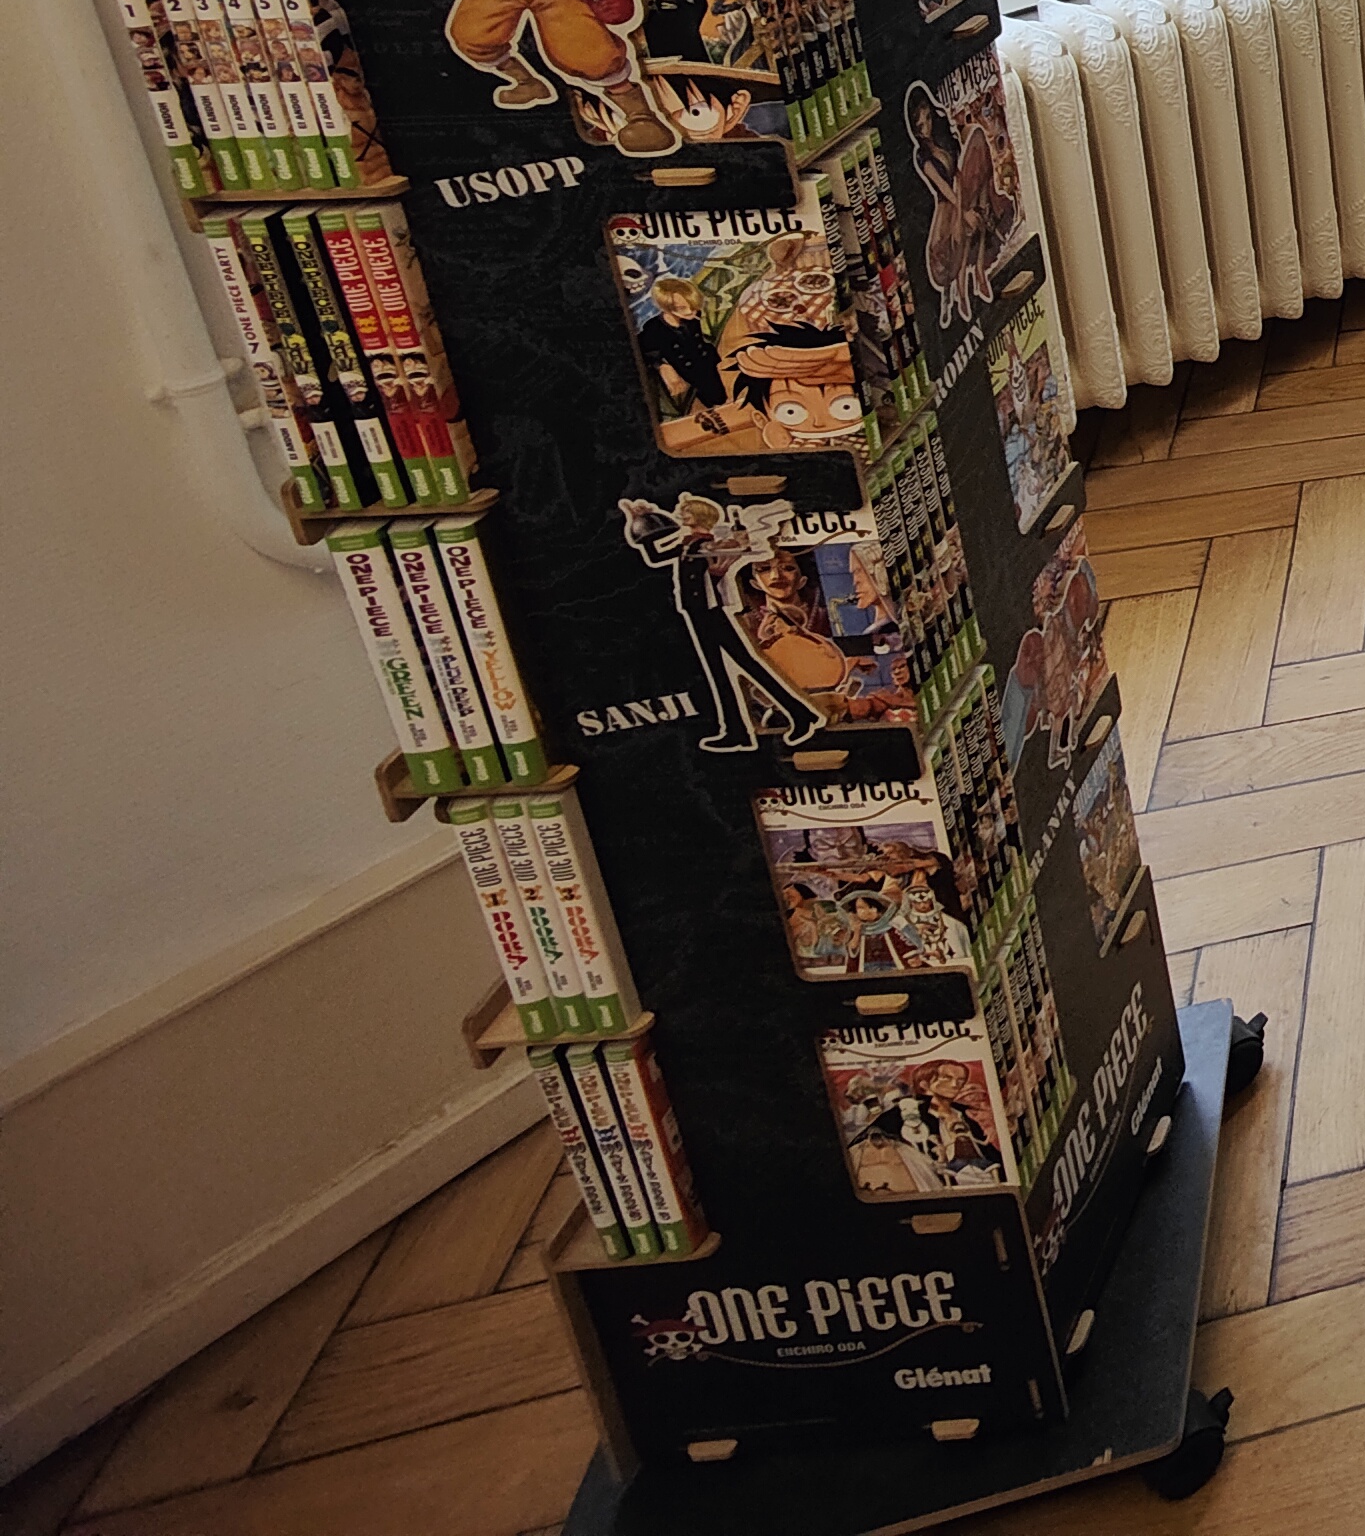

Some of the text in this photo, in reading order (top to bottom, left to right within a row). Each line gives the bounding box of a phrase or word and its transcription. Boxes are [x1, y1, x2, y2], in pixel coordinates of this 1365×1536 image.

[124, 5, 136, 17] 1
[434, 154, 587, 210] USOPP
[328, 238, 373, 312] ONE PIECE
[363, 237, 407, 311] ONE PIECE
[247, 343, 260, 354] 7
[576, 690, 700, 738] SANJI
[460, 827, 502, 888] ONE PIECE
[499, 824, 538, 882] ONE PIECE
[537, 823, 575, 882] ONE PIECE
[1052, 1101, 1097, 1220] ONE
[1092, 980, 1149, 1130] PIECE
[688, 1270, 963, 1345] ONE PIECE
[776, 1340, 866, 1358] EIICHIRO ODA
[894, 1364, 992, 1389] Glénat
